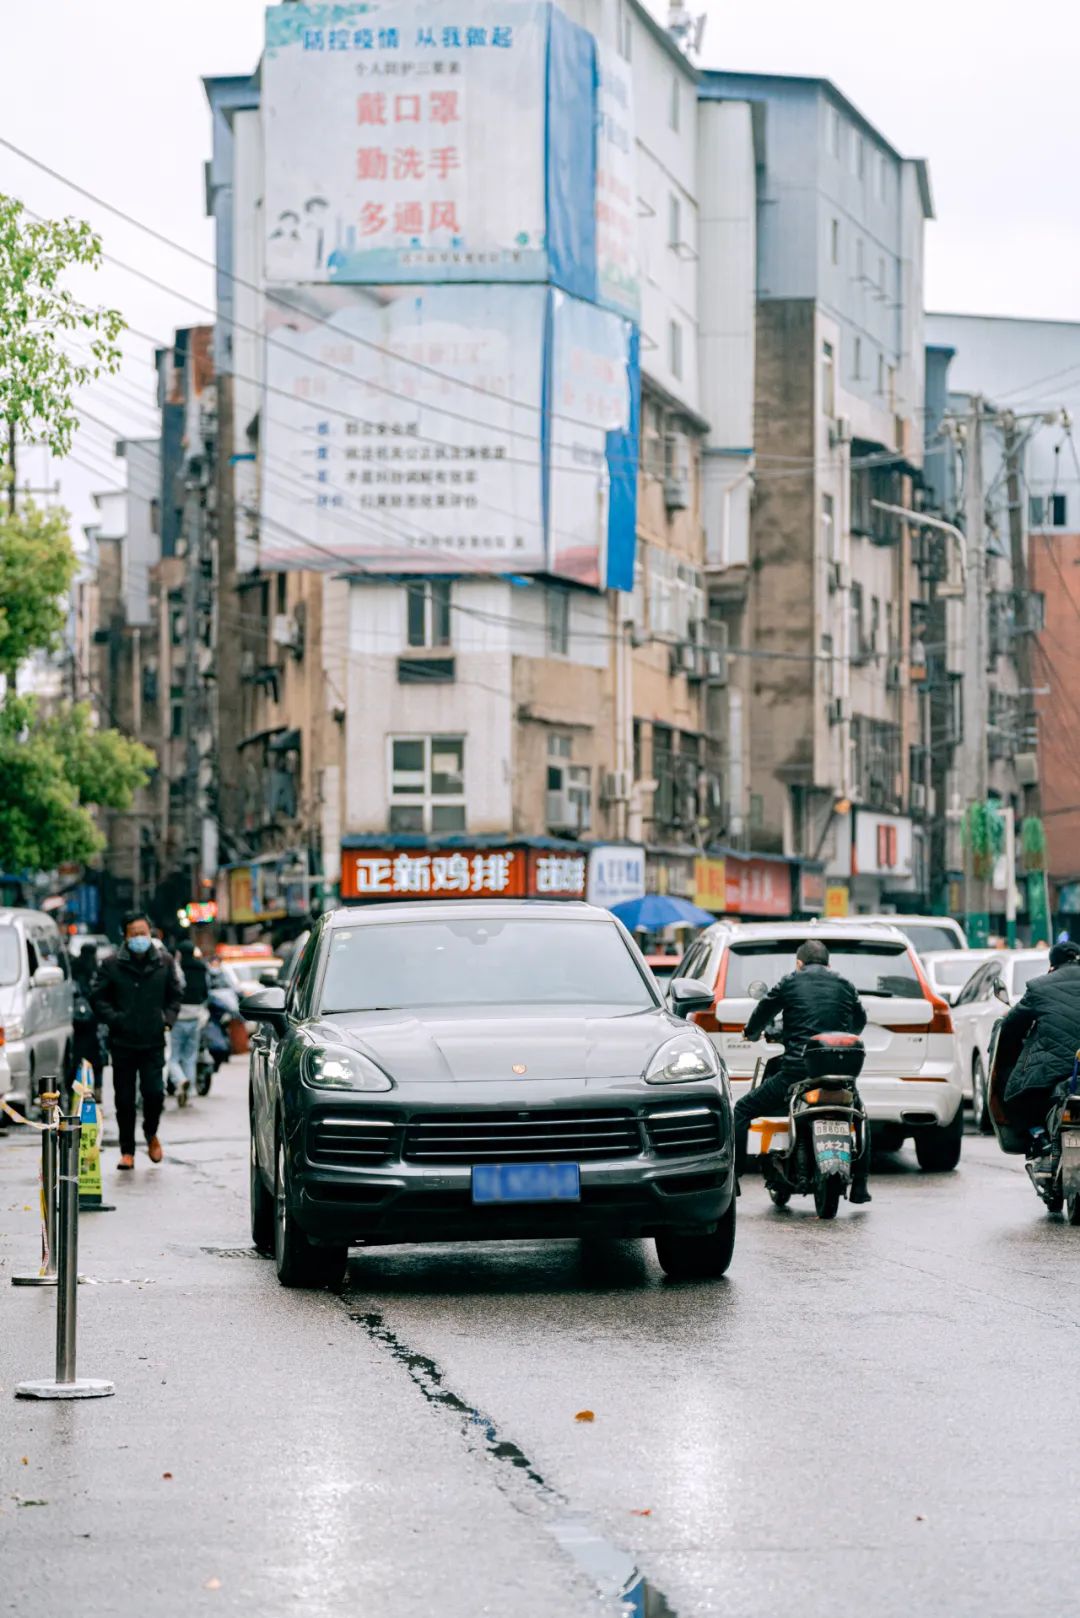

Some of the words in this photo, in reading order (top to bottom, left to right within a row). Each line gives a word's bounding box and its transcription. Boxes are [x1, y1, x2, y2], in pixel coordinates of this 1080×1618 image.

[302, 27, 400, 51] 防控疫情
[415, 26, 513, 49] 从我做起
[356, 90, 460, 126] 戴口罩
[356, 147, 460, 181] 勤洗手
[358, 201, 461, 236] 多通风
[356, 852, 510, 893] 正新鸡排
